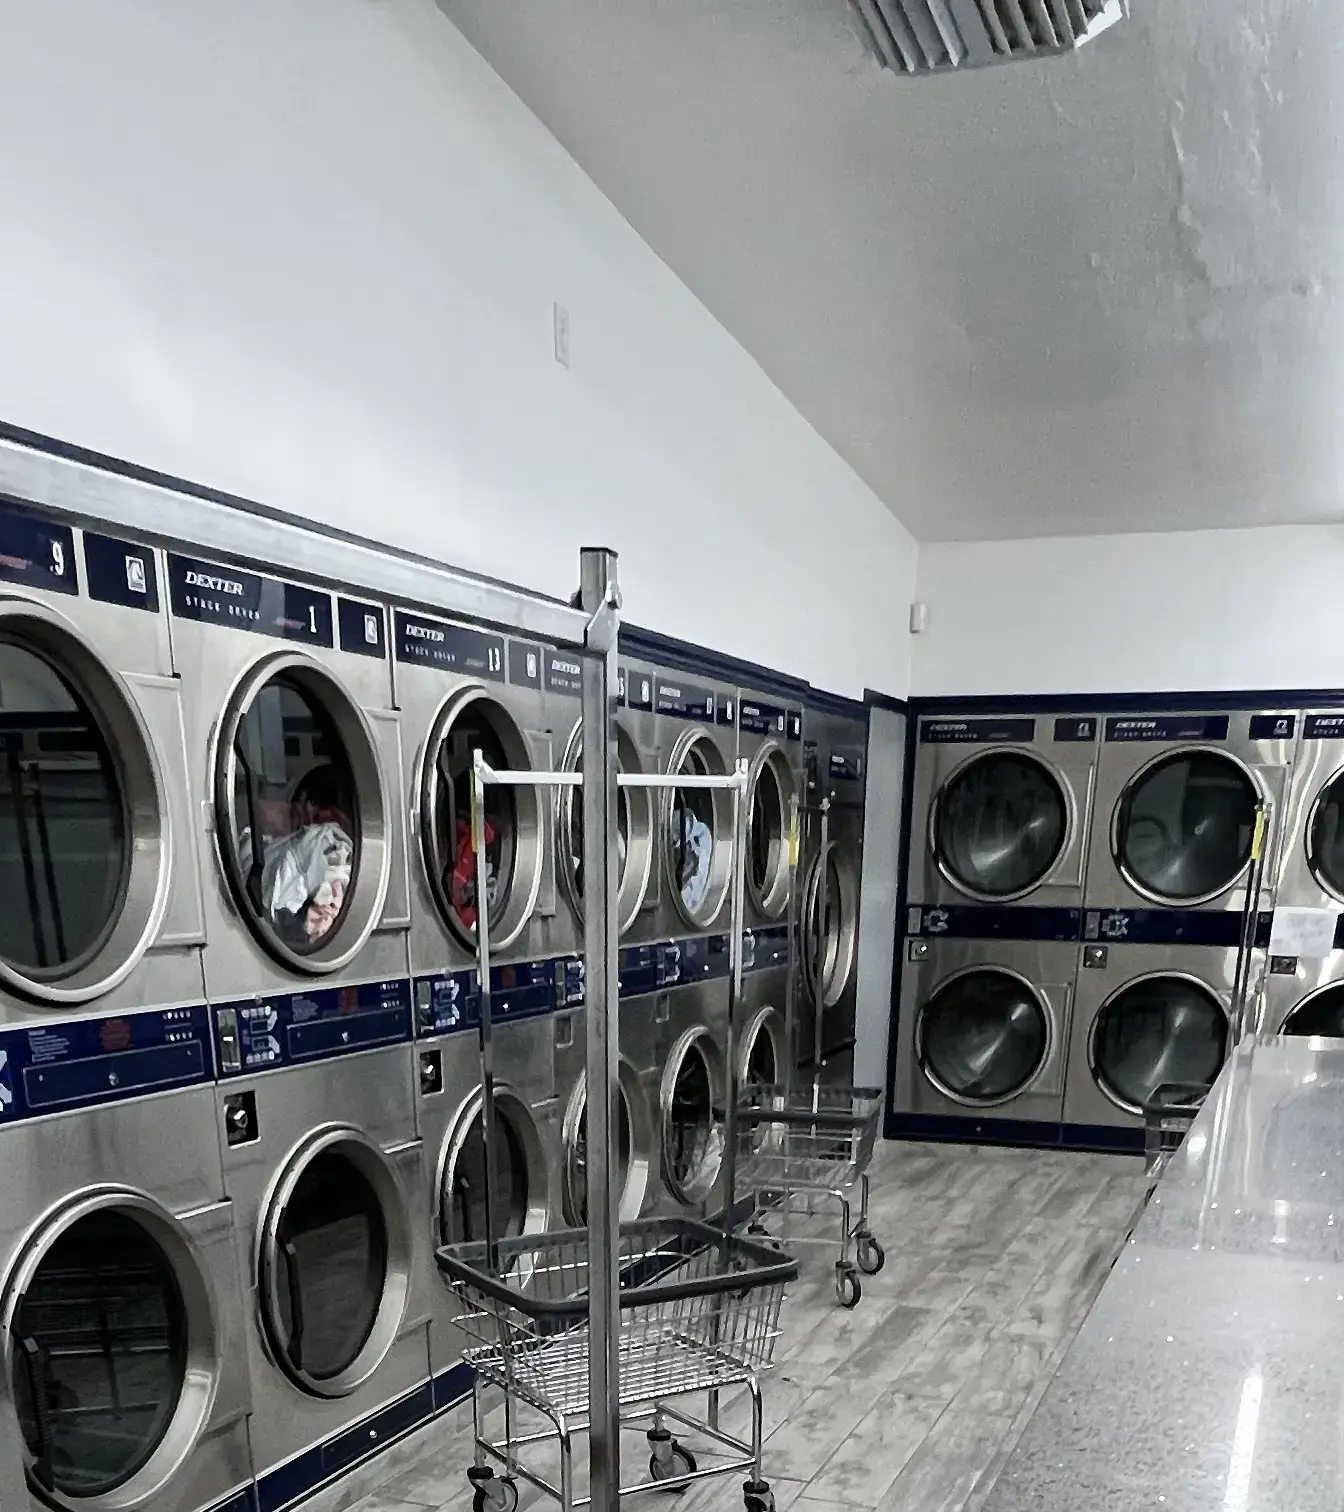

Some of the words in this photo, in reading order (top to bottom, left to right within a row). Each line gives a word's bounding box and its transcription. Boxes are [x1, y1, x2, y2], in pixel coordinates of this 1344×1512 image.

[49, 541, 65, 576] 9
[184, 570, 243, 596] DEXTER
[405, 623, 445, 643] DEXTER
